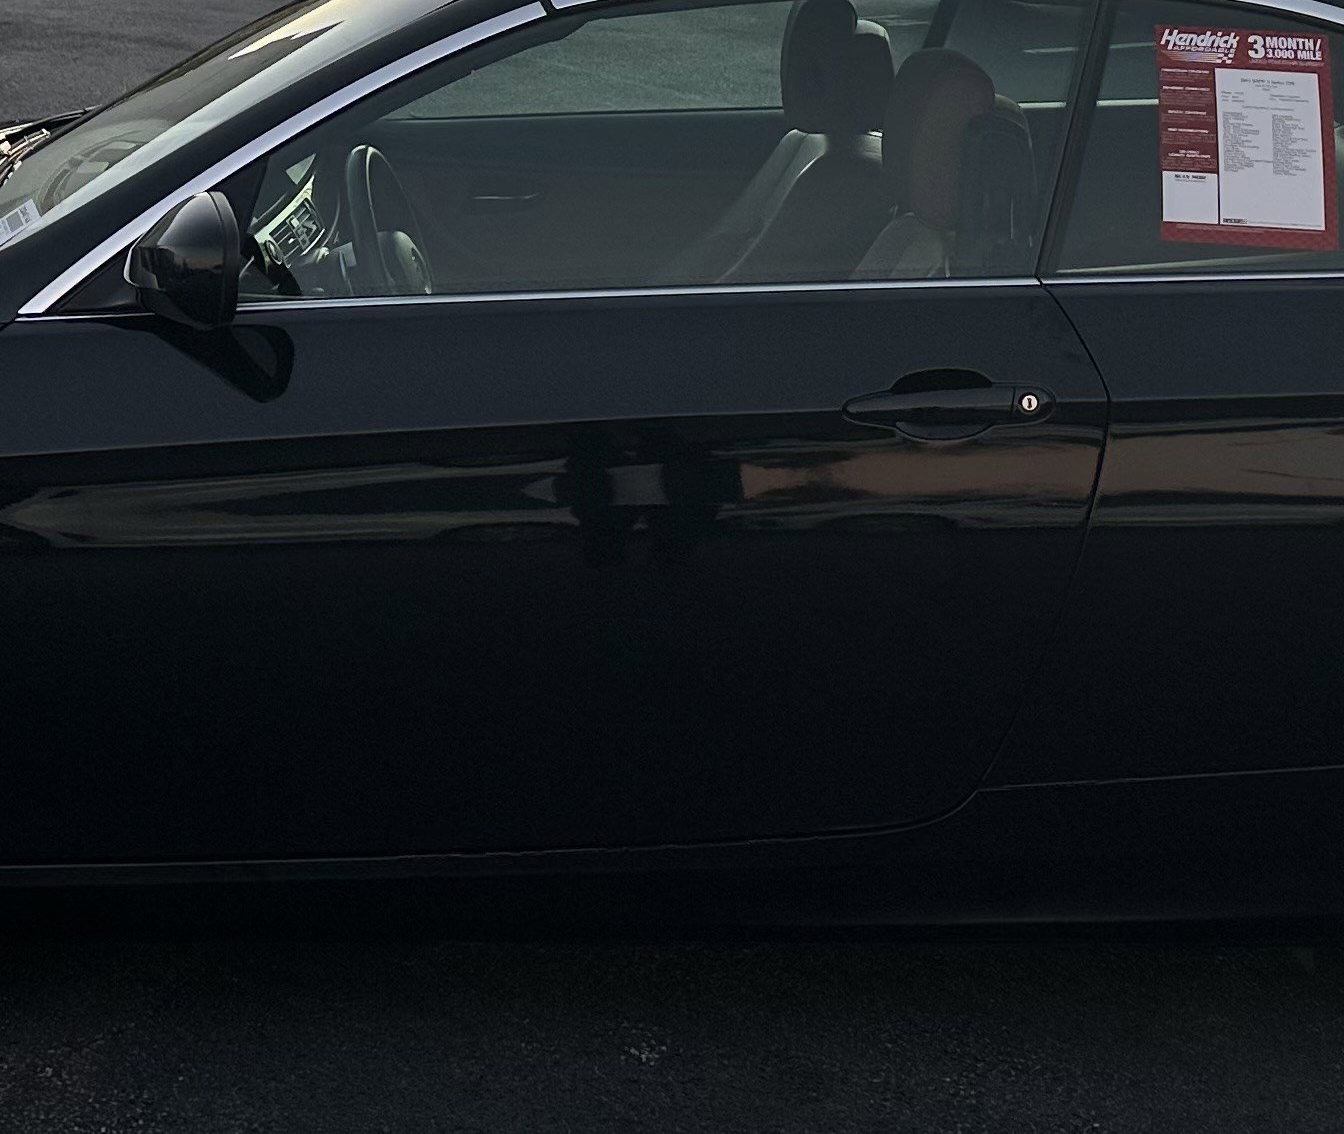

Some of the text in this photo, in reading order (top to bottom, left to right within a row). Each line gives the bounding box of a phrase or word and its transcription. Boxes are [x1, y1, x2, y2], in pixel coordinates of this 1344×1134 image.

[1160, 28, 1240, 50] Hendrick
[1247, 34, 1266, 59] 3
[1265, 36, 1322, 51] MONTH/
[1173, 45, 1236, 54] AFFORDABLE
[1297, 50, 1323, 61] MILE
